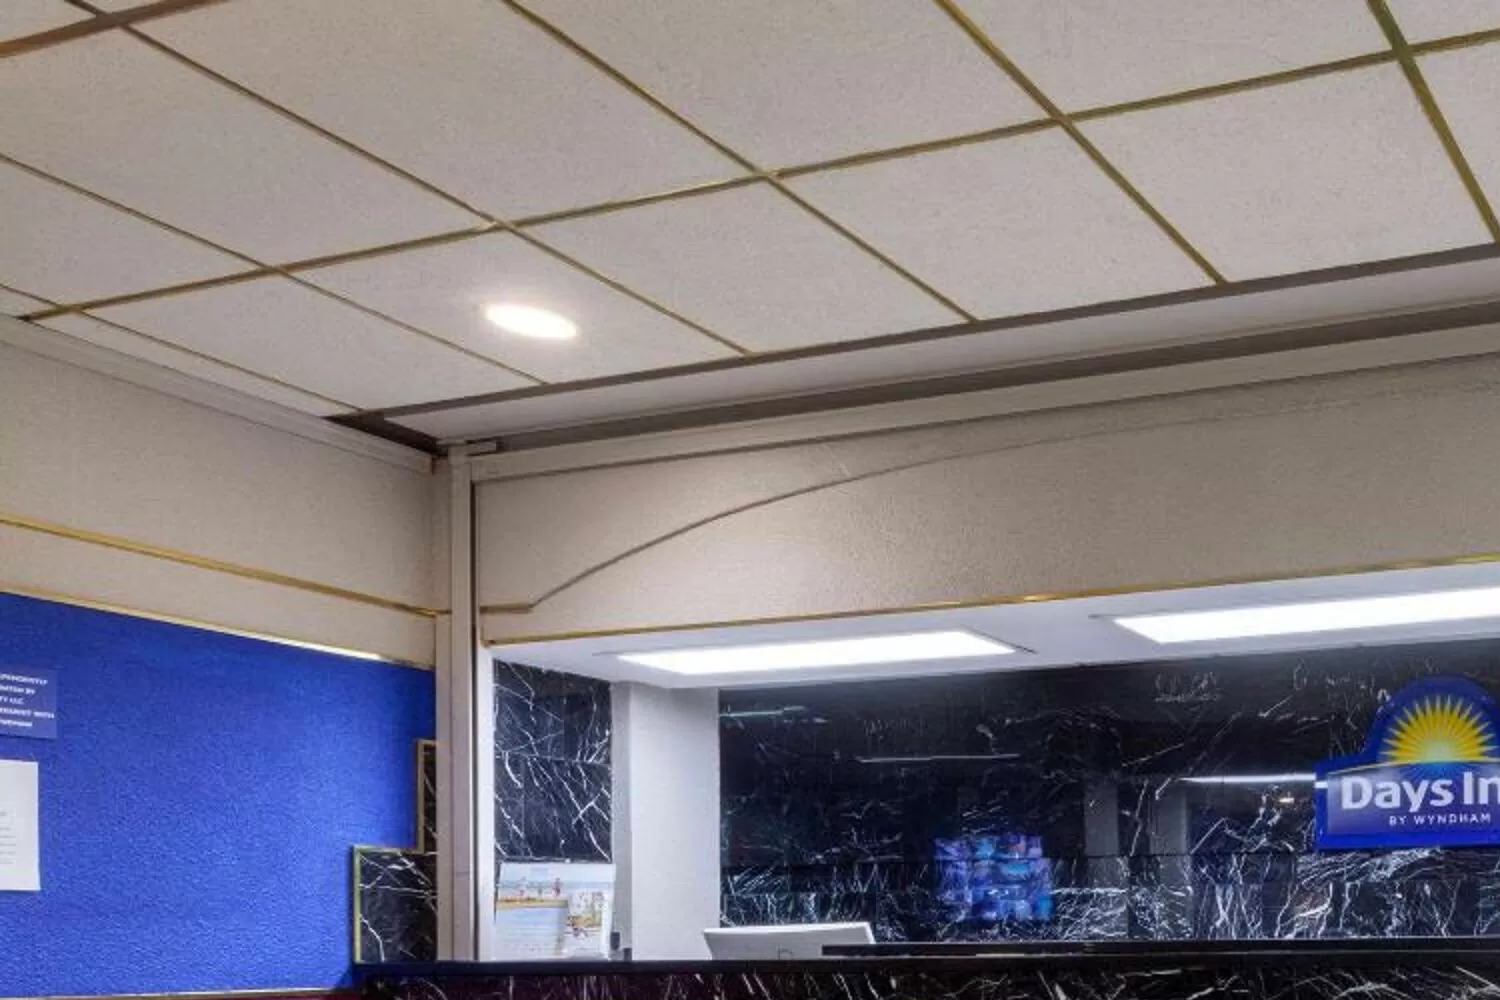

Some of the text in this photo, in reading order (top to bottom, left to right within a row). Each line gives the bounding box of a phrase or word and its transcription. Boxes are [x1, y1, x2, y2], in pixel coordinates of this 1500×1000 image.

[1341, 775, 1454, 813] Days
[1389, 813, 1491, 826] BY WYNDHAM
